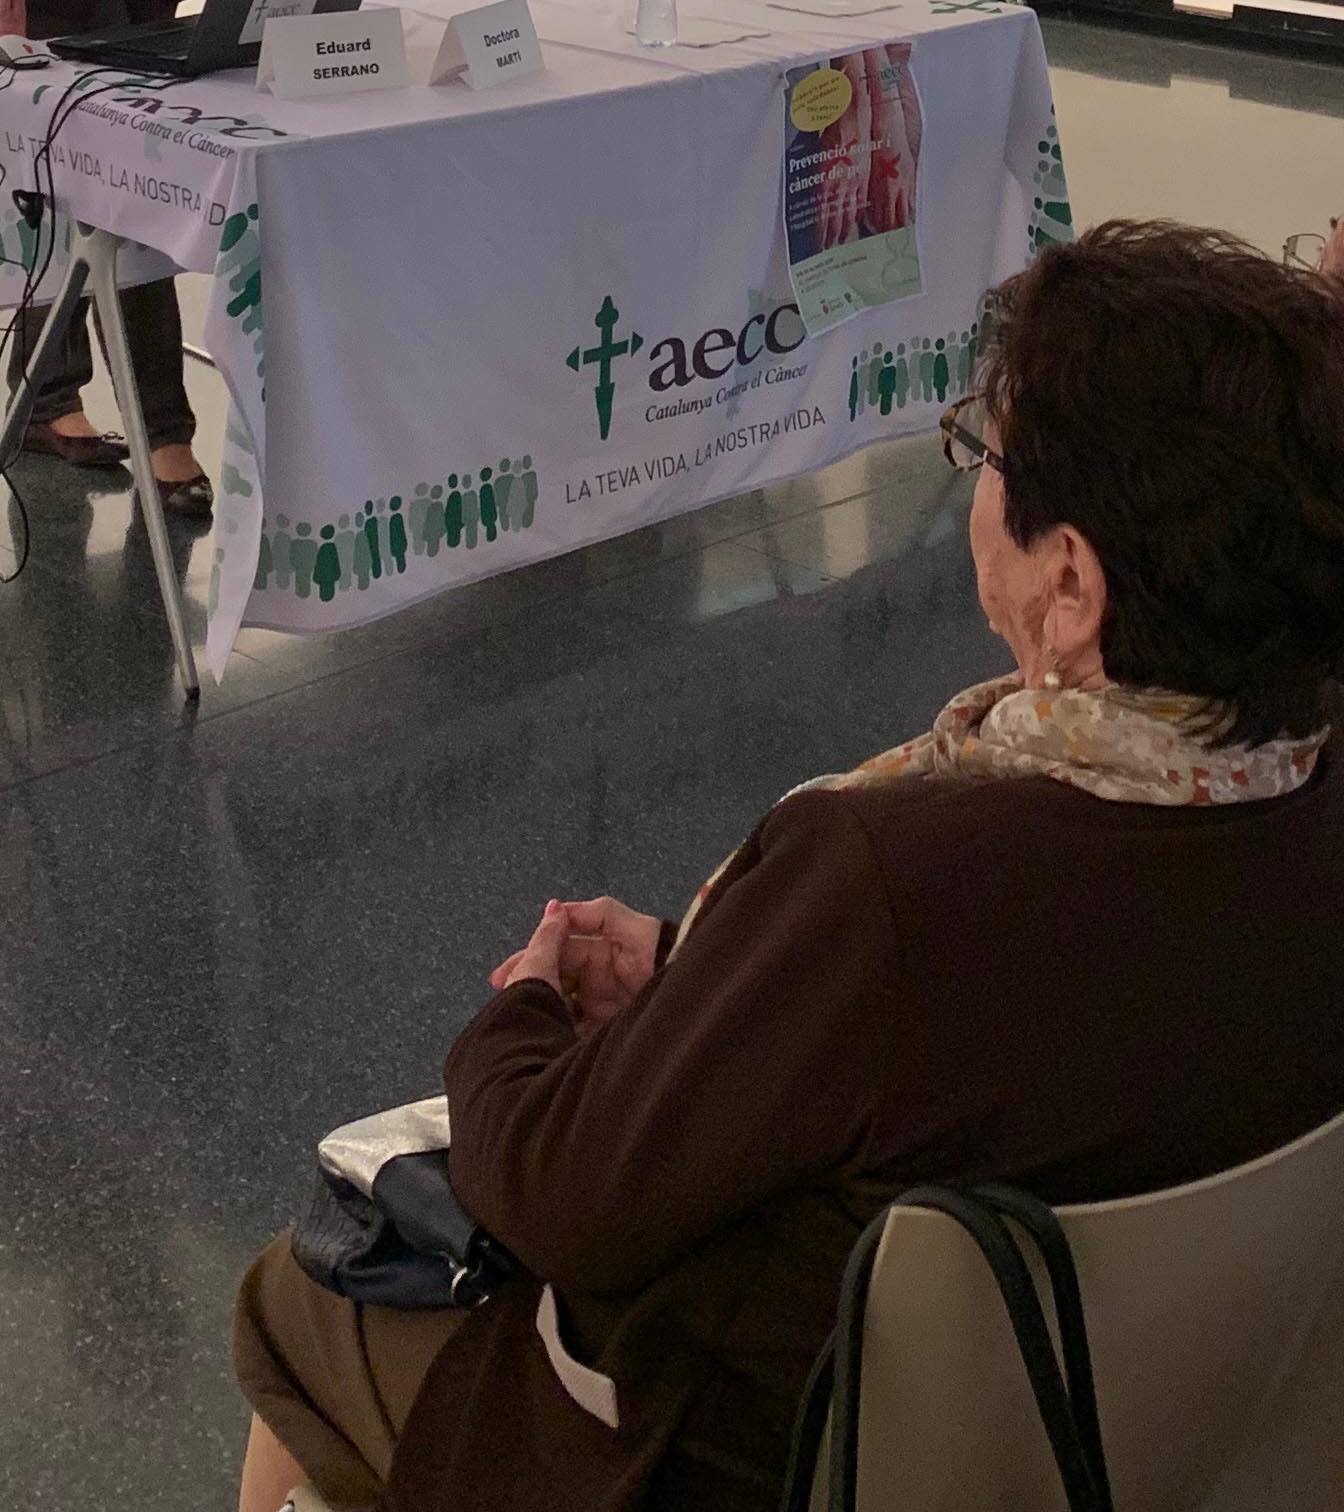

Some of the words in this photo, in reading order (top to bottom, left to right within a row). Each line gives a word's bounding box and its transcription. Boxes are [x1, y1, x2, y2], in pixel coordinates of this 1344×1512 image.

[316, 38, 371, 55] Eduard
[483, 28, 520, 48] Doctora
[313, 63, 380, 80] SERRANO
[130, 113, 173, 141] Contra
[174, 128, 186, 145] el
[6, 131, 25, 153] LA
[68, 148, 105, 185] VIDA,
[109, 164, 130, 192] LA
[134, 173, 201, 212] NOSTRA
[789, 144, 847, 173] Prevenció
[828, 166, 843, 181] de
[648, 303, 806, 392] aecc
[645, 395, 713, 423] Catalunya
[751, 371, 762, 390] el
[764, 363, 808, 385] Càncer
[566, 480, 591, 504] LA
[595, 465, 641, 496] TEVA
[644, 453, 690, 481] VIDA,
[695, 443, 712, 467] LA
[714, 421, 781, 457] NOSTRA
[783, 406, 826, 434] VIDA
